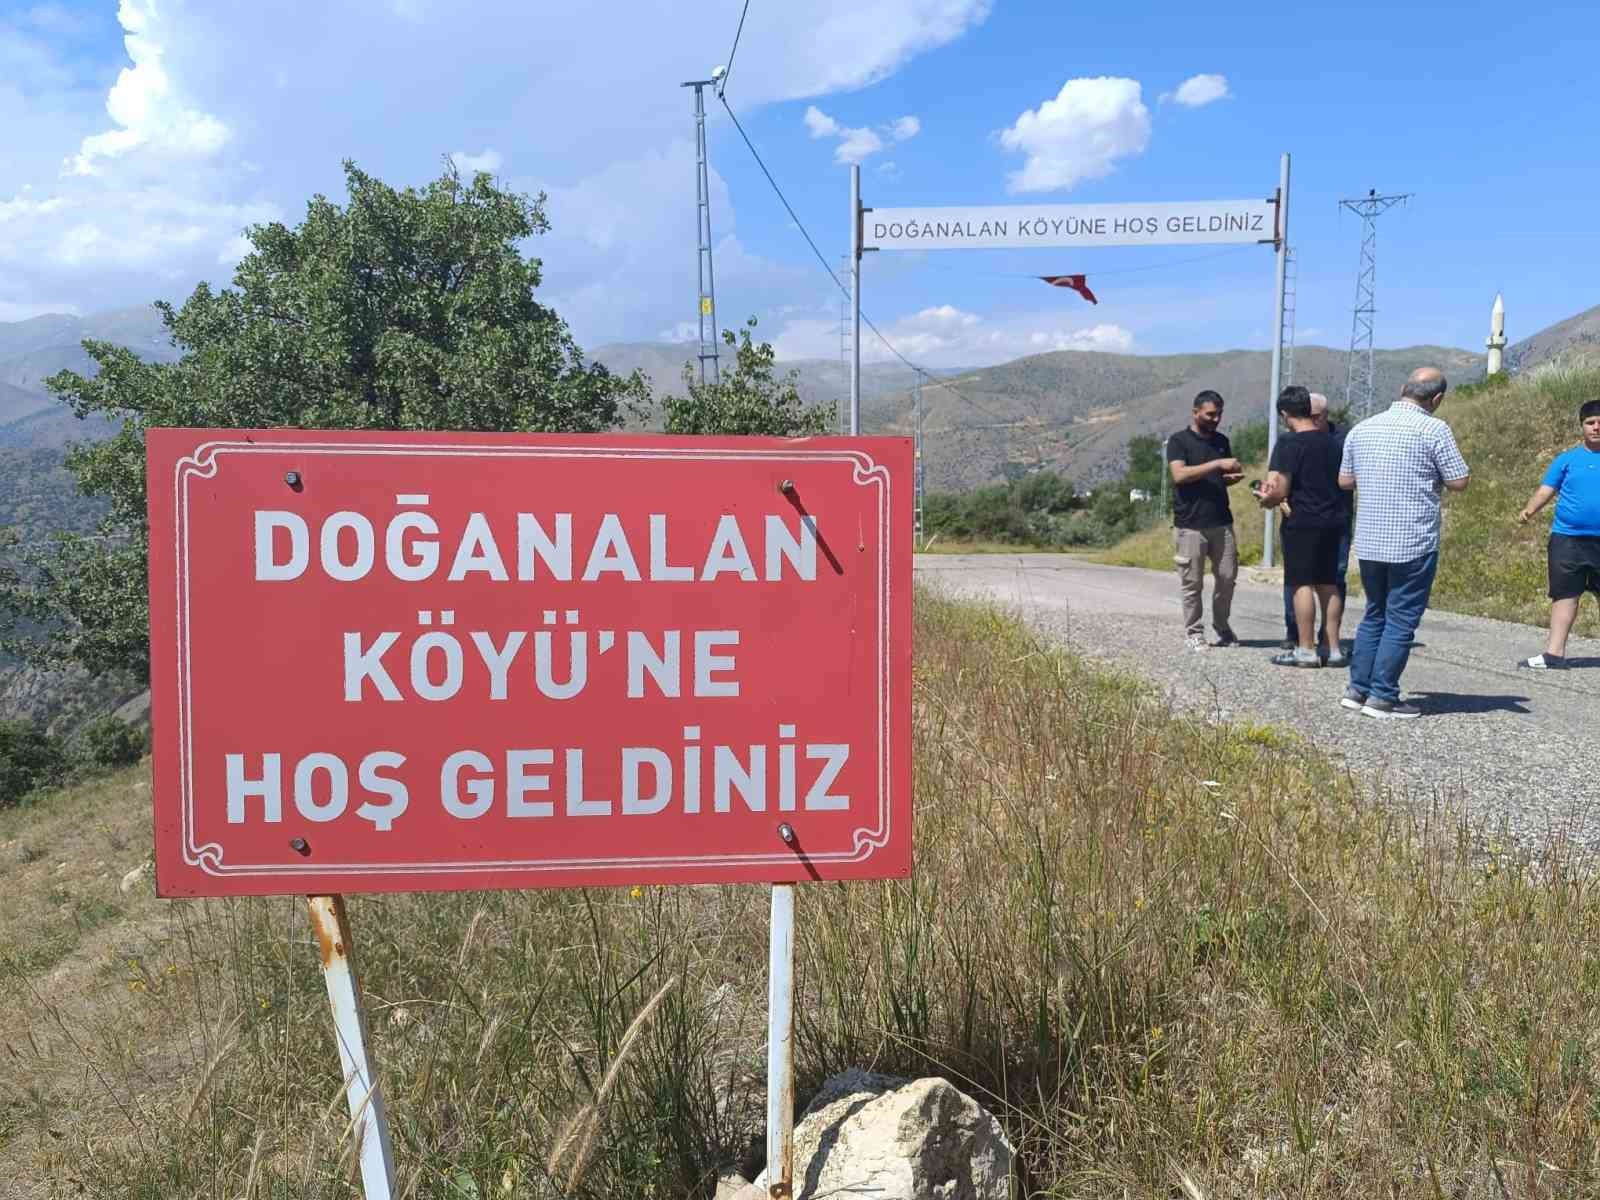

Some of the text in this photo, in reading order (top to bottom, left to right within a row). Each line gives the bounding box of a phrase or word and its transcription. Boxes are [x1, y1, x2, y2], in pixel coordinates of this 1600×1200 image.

[874, 211, 1264, 239] DOĞANALAN KÖYÜNE HOŞ GELDİNİZ
[343, 610, 740, 703] KÖYÜ'NE
[225, 724, 850, 832] HOŞ GELDİNİZ
